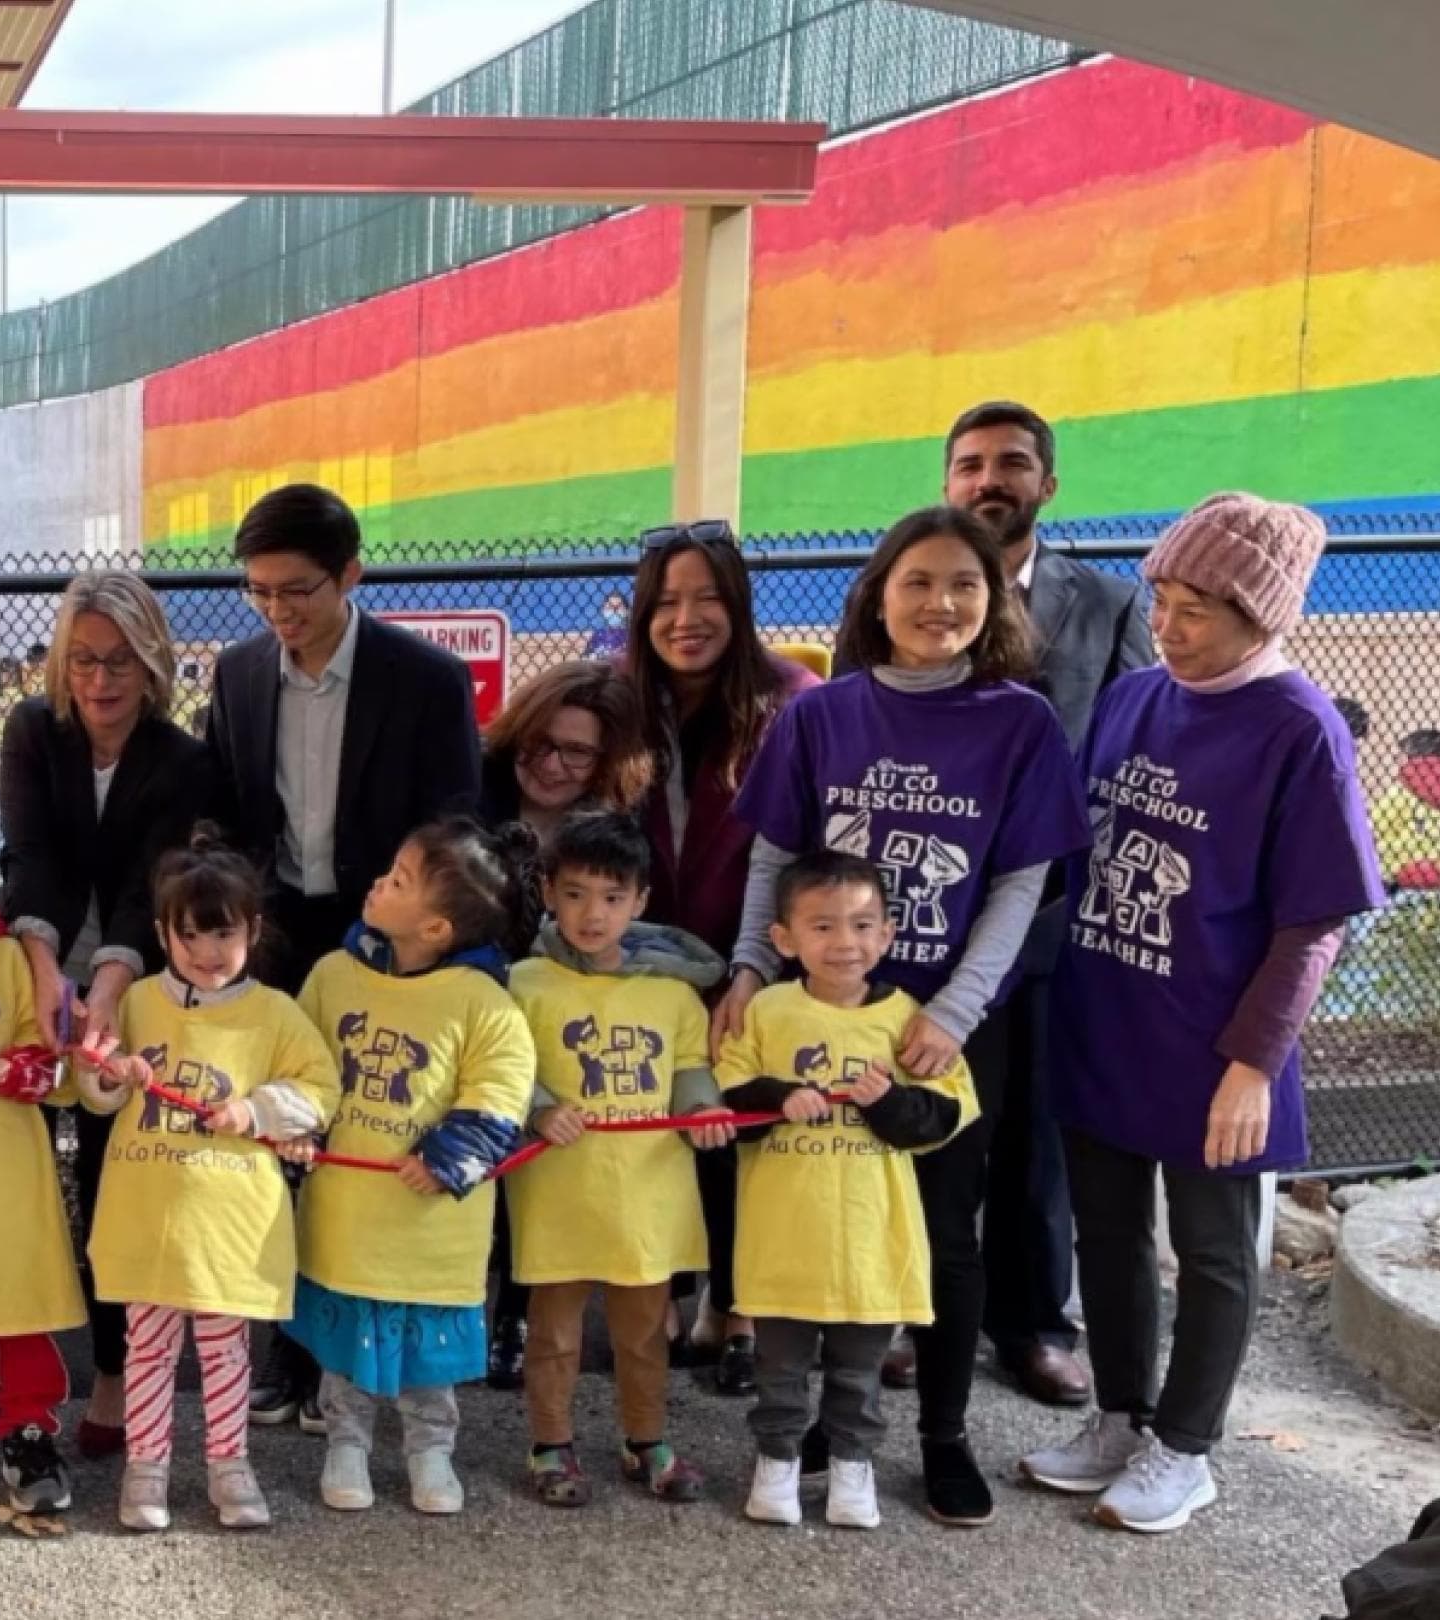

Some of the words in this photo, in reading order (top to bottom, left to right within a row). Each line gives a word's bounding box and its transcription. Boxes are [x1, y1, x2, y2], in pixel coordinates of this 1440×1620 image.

[825, 785, 982, 818] PRESCHOOL
[125, 1141, 148, 1162] Co
[154, 1142, 257, 1173] Preschool
[794, 1136, 825, 1155] Co
